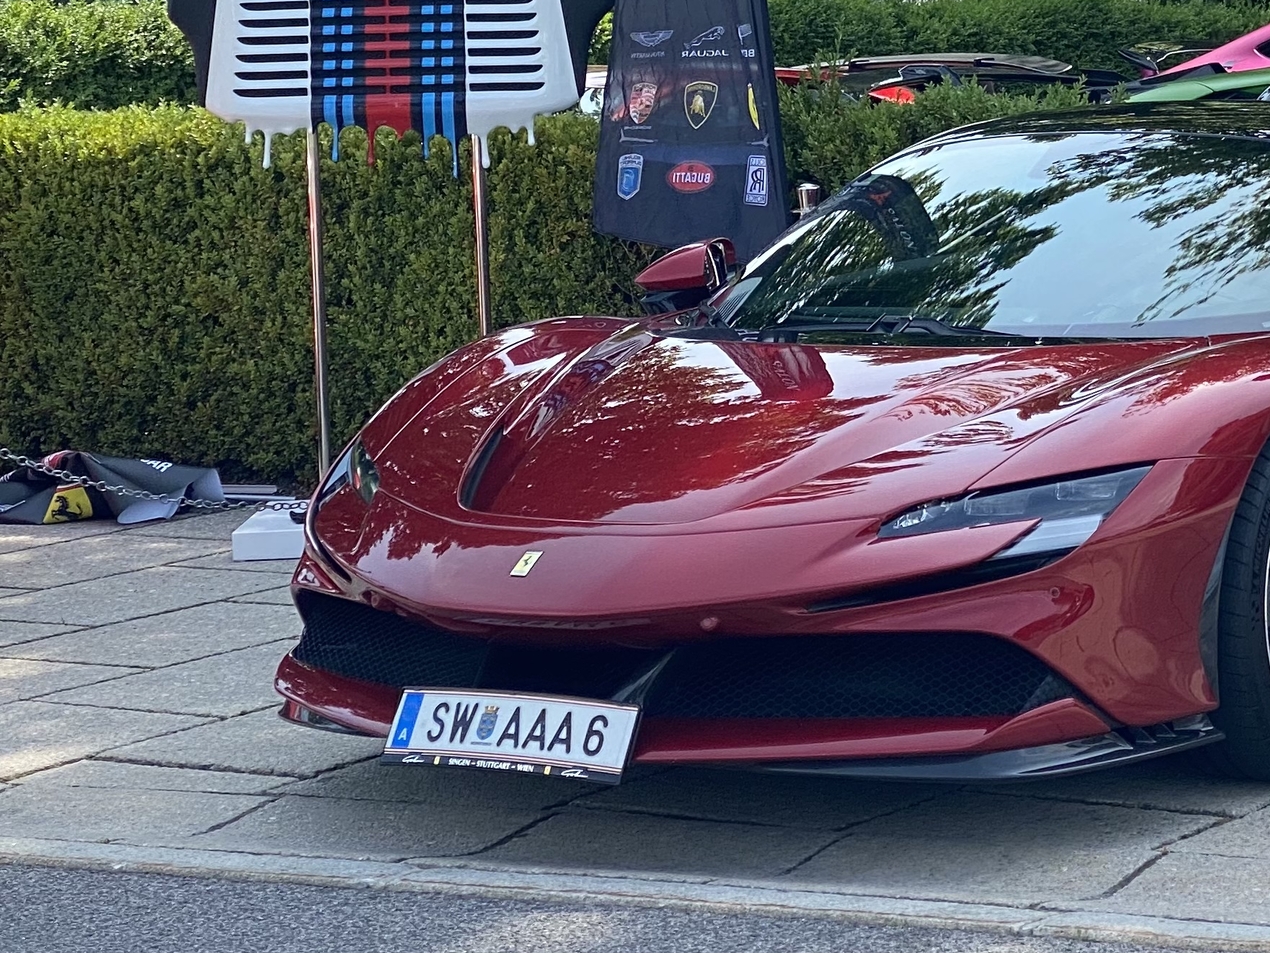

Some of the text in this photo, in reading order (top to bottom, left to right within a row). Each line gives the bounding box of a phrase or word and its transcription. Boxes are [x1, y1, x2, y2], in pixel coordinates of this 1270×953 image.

[398, 727, 407, 740] A
[427, 702, 479, 744] SW
[448, 757, 471, 766] SINGEN
[476, 759, 511, 769] STUTTGART
[516, 763, 534, 772] WIEN
